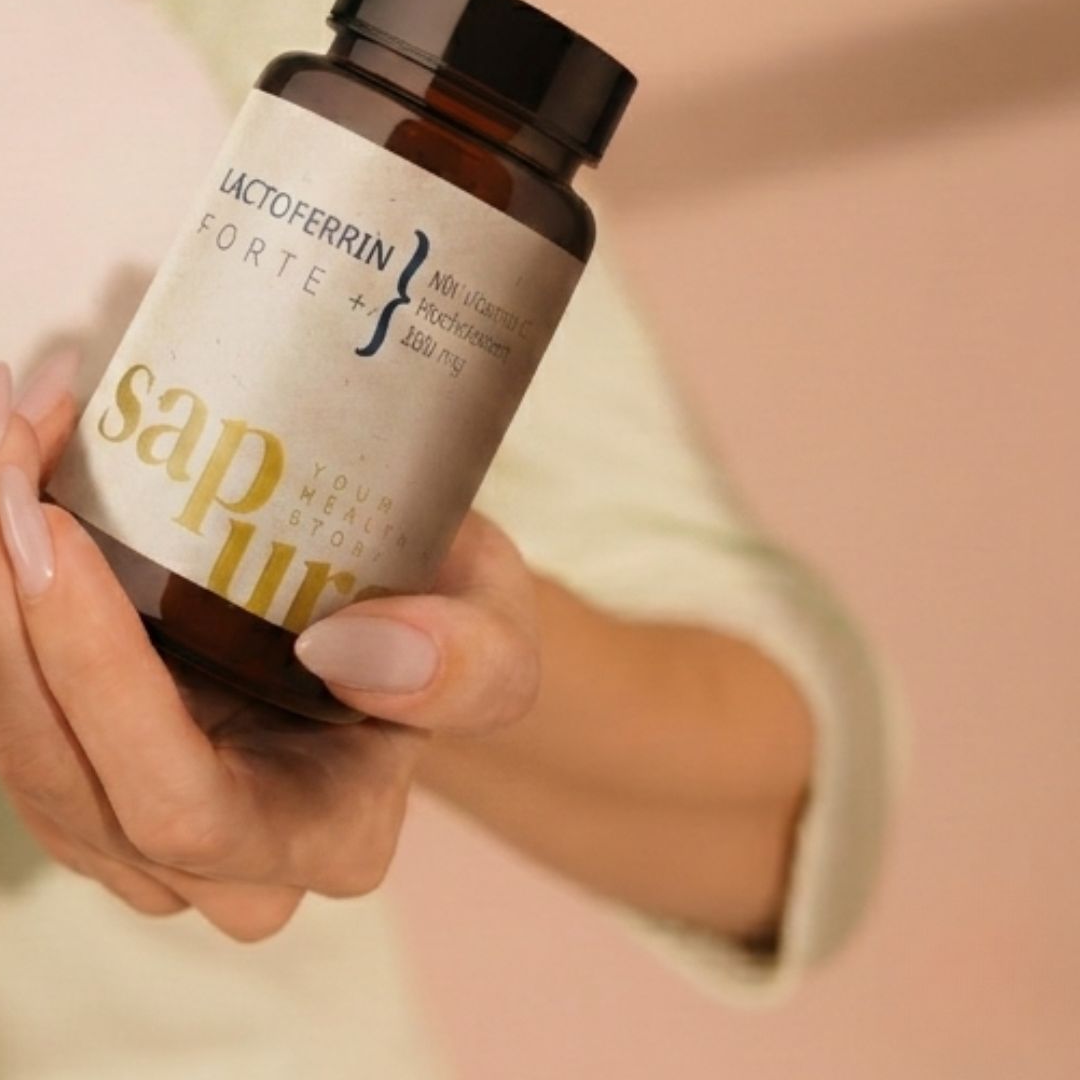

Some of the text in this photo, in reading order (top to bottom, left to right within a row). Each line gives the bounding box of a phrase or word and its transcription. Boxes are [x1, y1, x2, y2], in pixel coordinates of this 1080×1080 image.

[196, 213, 327, 296] FORTE
[219, 168, 395, 271] LACTOFERRIN
[97, 363, 286, 537] sap
[207, 517, 397, 635] ur
